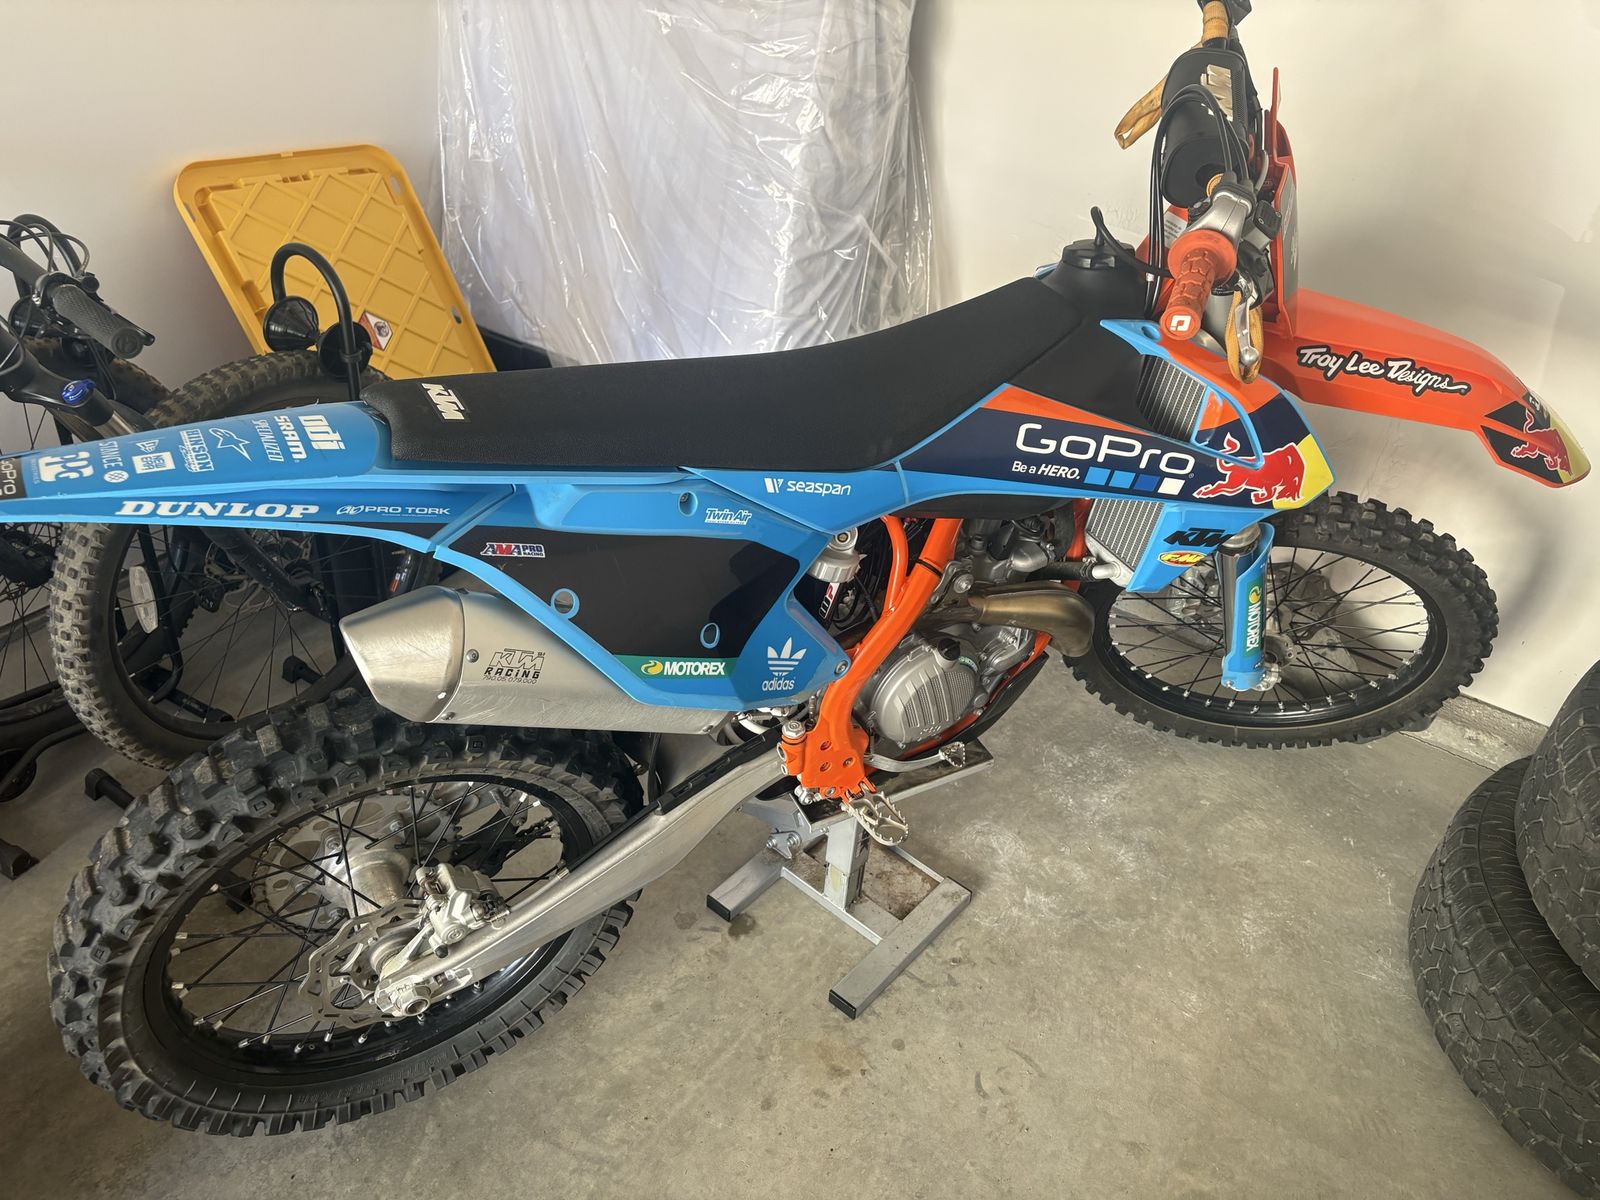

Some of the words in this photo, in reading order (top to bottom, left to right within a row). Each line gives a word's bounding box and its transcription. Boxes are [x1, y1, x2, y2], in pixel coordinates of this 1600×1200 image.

[1300, 347, 1344, 378] Troy
[1346, 353, 1385, 376] Lee
[1387, 360, 1468, 393] Designs
[422, 383, 465, 419] KTM
[252, 419, 284, 461] SPECIALIZED
[274, 416, 307, 459] SRAM
[99, 441, 123, 468] STANCE
[188, 429, 214, 471] HINSON
[1016, 423, 1195, 475] GoPro
[141, 456, 155, 470] ERA
[152, 454, 166, 468] NEW
[1012, 461, 1027, 473] Be
[1029, 466, 1036, 474] a
[787, 480, 851, 496] seaspan
[115, 501, 319, 518] DUNLOP
[706, 508, 734, 521] Twin
[734, 510, 752, 521] Air
[482, 544, 522, 556] AMA
[1246, 600, 1261, 652] MOTOREX
[489, 648, 545, 671] KTM
[663, 661, 725, 675] MOTOREX
[762, 678, 795, 691] adidas
